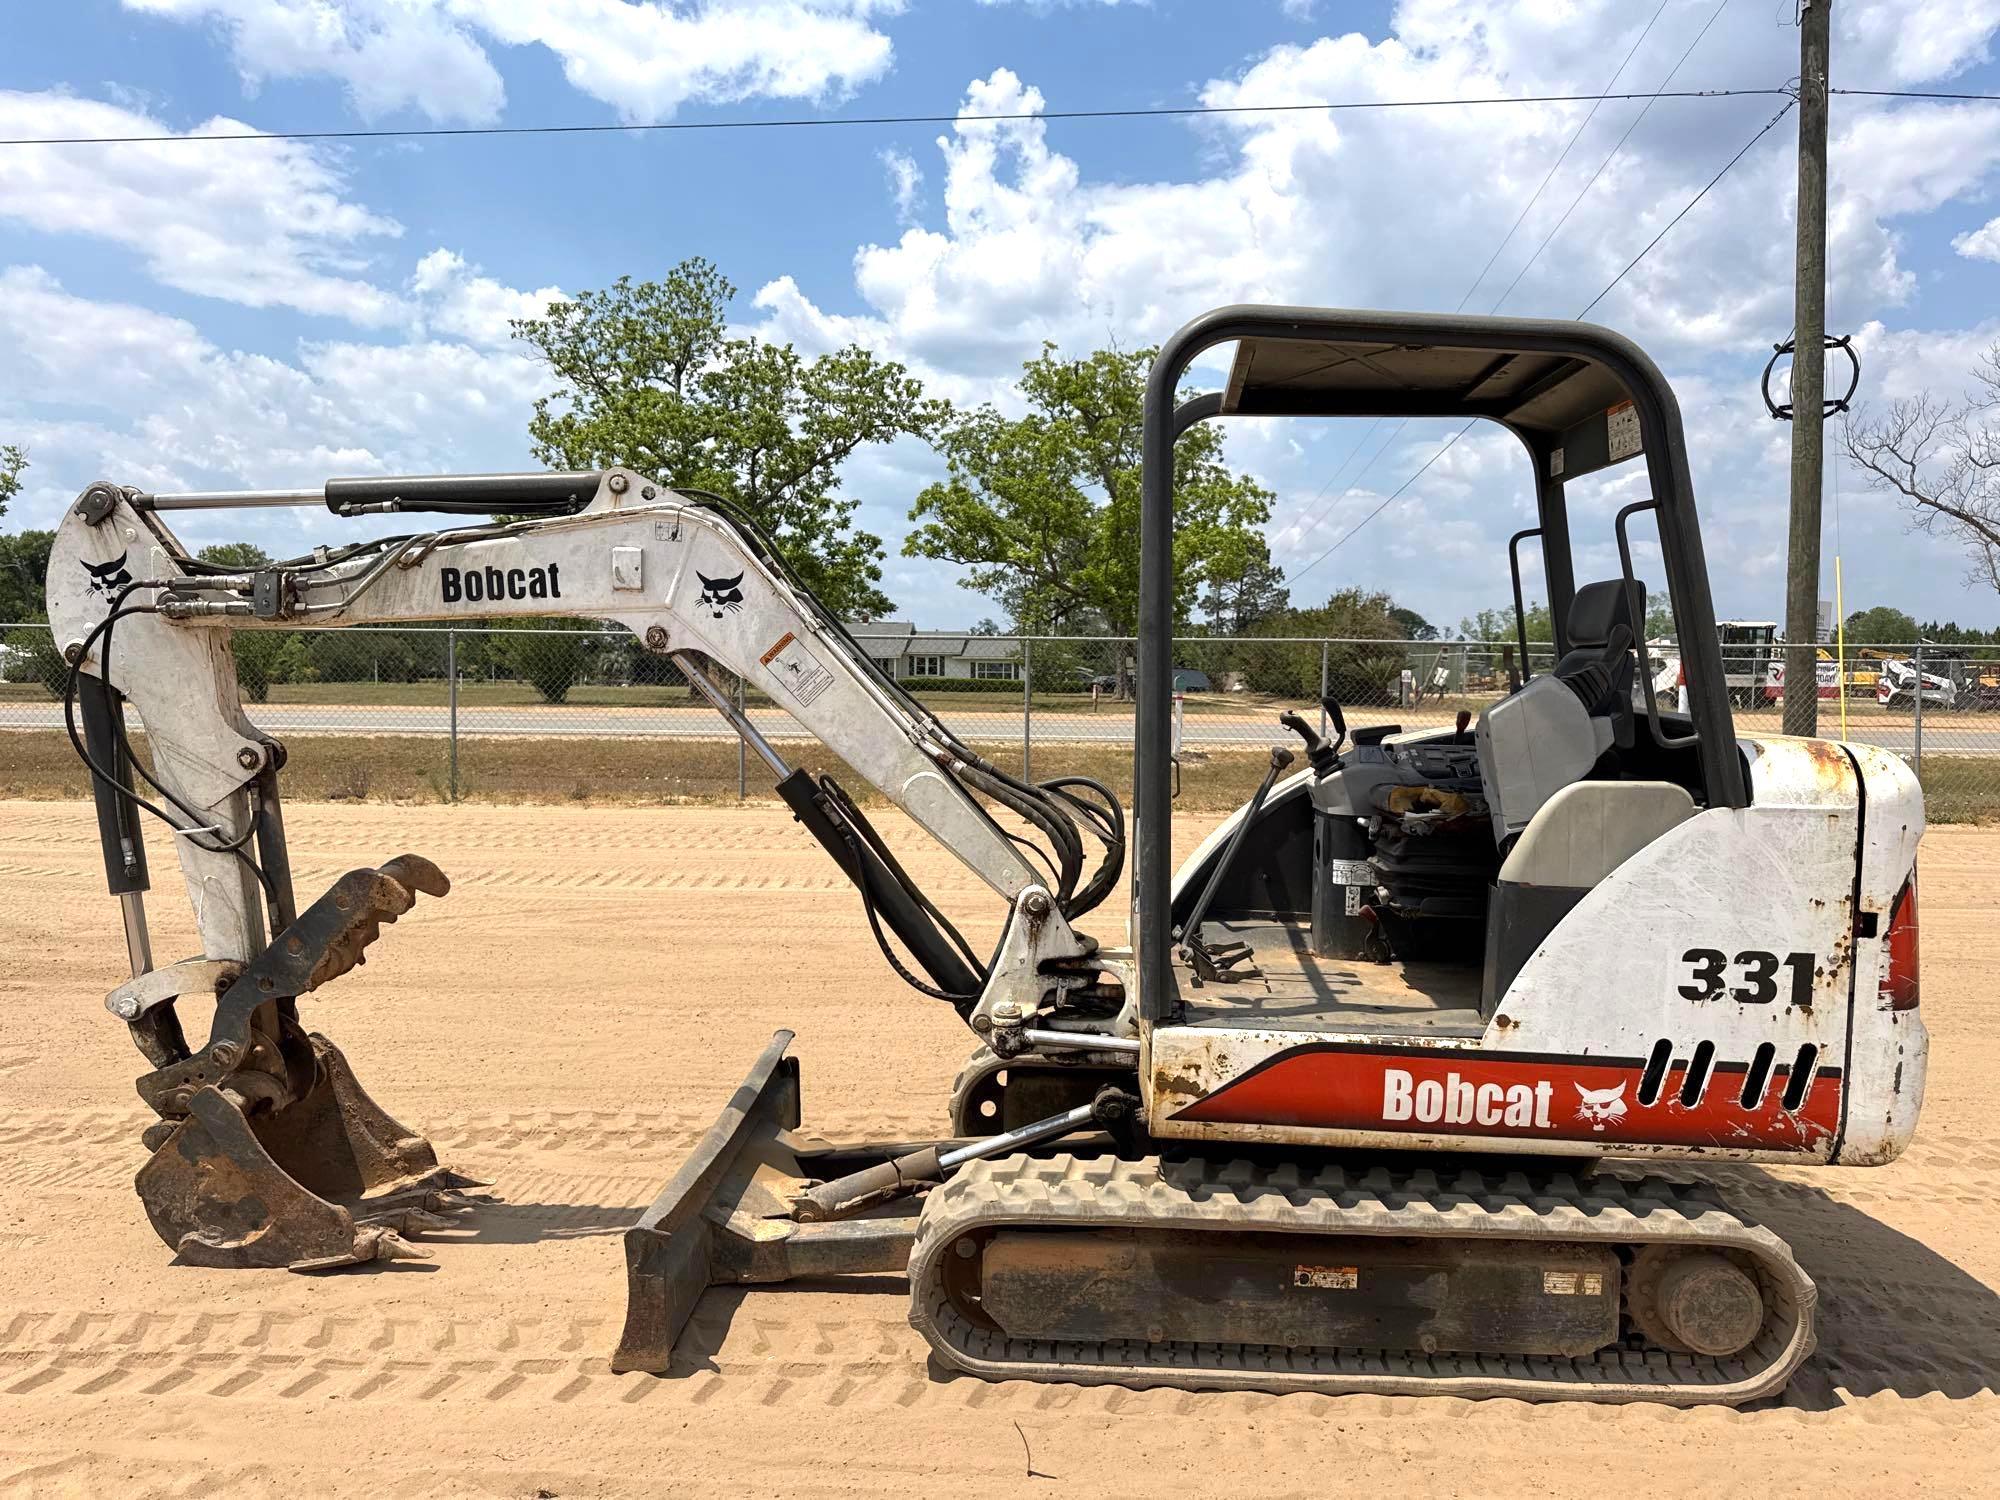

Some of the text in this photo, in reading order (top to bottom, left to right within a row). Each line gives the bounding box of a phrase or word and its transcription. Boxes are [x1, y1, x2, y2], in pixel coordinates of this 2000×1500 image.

[441, 563, 561, 603] Bobcat
[1678, 948, 1815, 1007] 331
[1382, 1068, 1555, 1129] Bobcat
